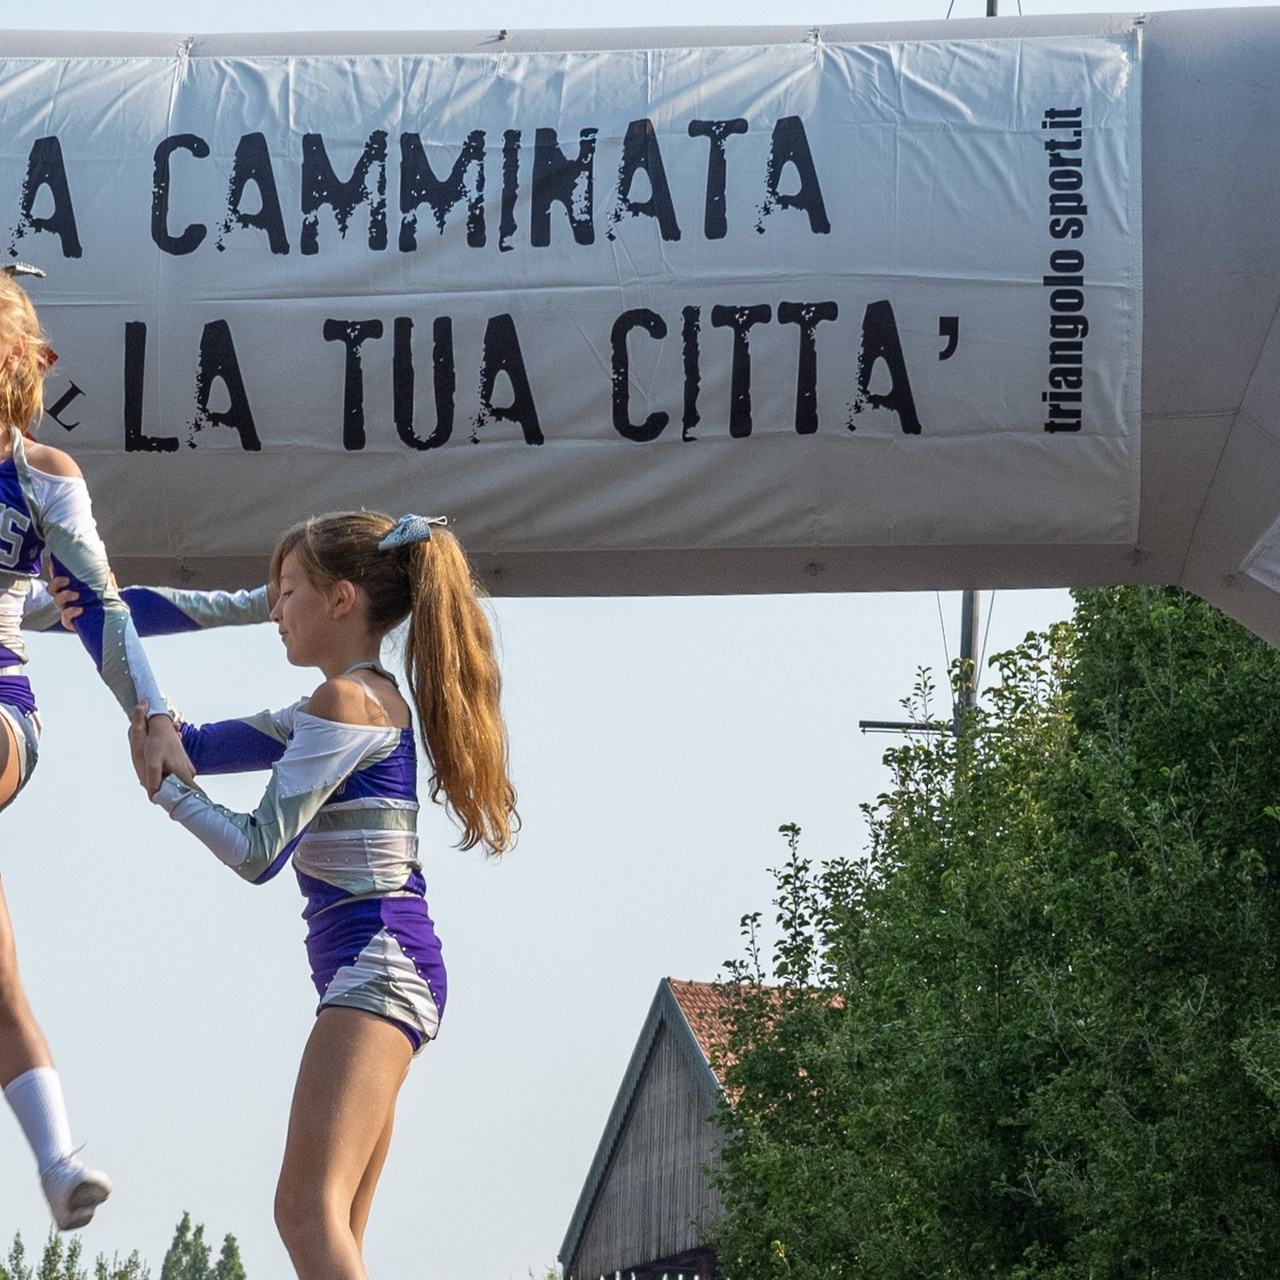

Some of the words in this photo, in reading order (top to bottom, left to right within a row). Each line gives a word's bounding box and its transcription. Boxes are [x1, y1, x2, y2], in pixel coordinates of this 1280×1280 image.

[151, 115, 832, 256] CAMMINATA
[1042, 106, 1085, 240] sport.it
[124, 319, 262, 454] LA
[323, 312, 545, 451] TUA
[1042, 248, 1089, 434] triangolo
